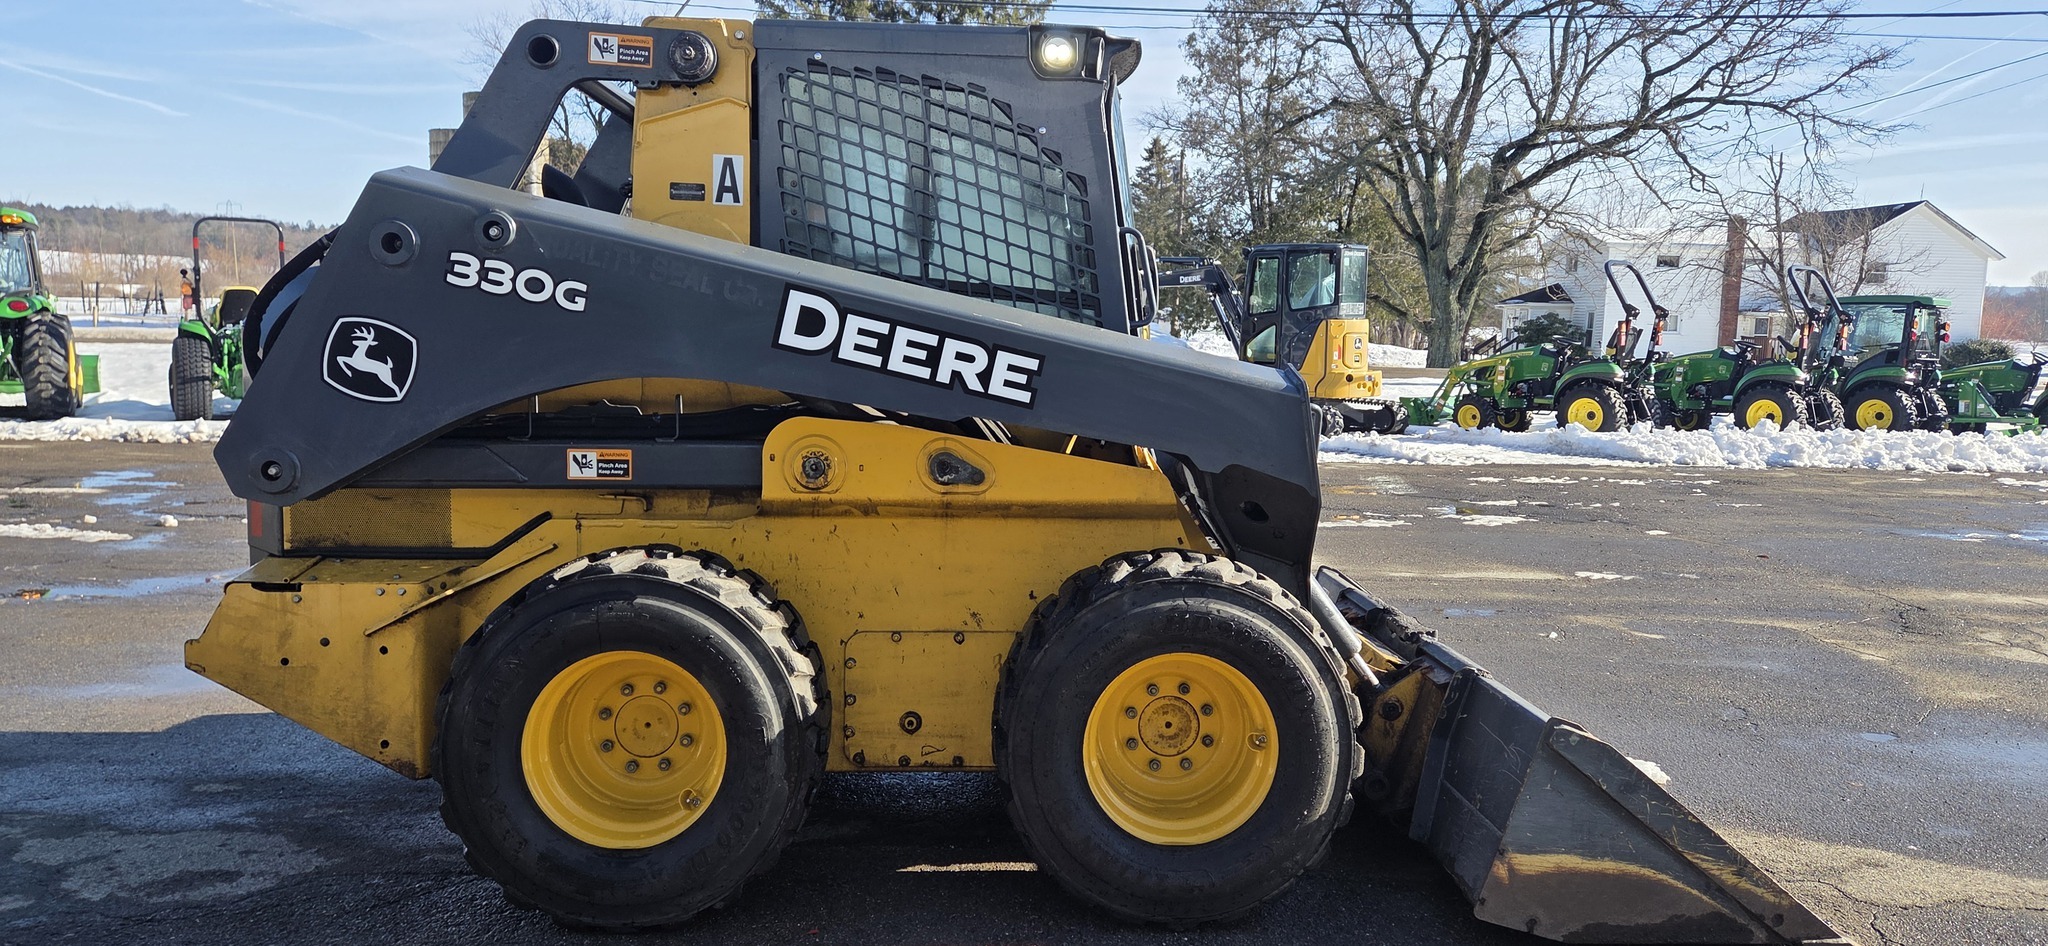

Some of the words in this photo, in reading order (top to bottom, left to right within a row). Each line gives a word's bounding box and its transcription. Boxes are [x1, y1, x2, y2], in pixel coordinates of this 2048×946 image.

[619, 47, 635, 55] Pinch
[715, 157, 741, 204] A
[446, 252, 590, 312] 330G
[1179, 274, 1202, 284] DEERE
[777, 289, 1040, 404] DEERE
